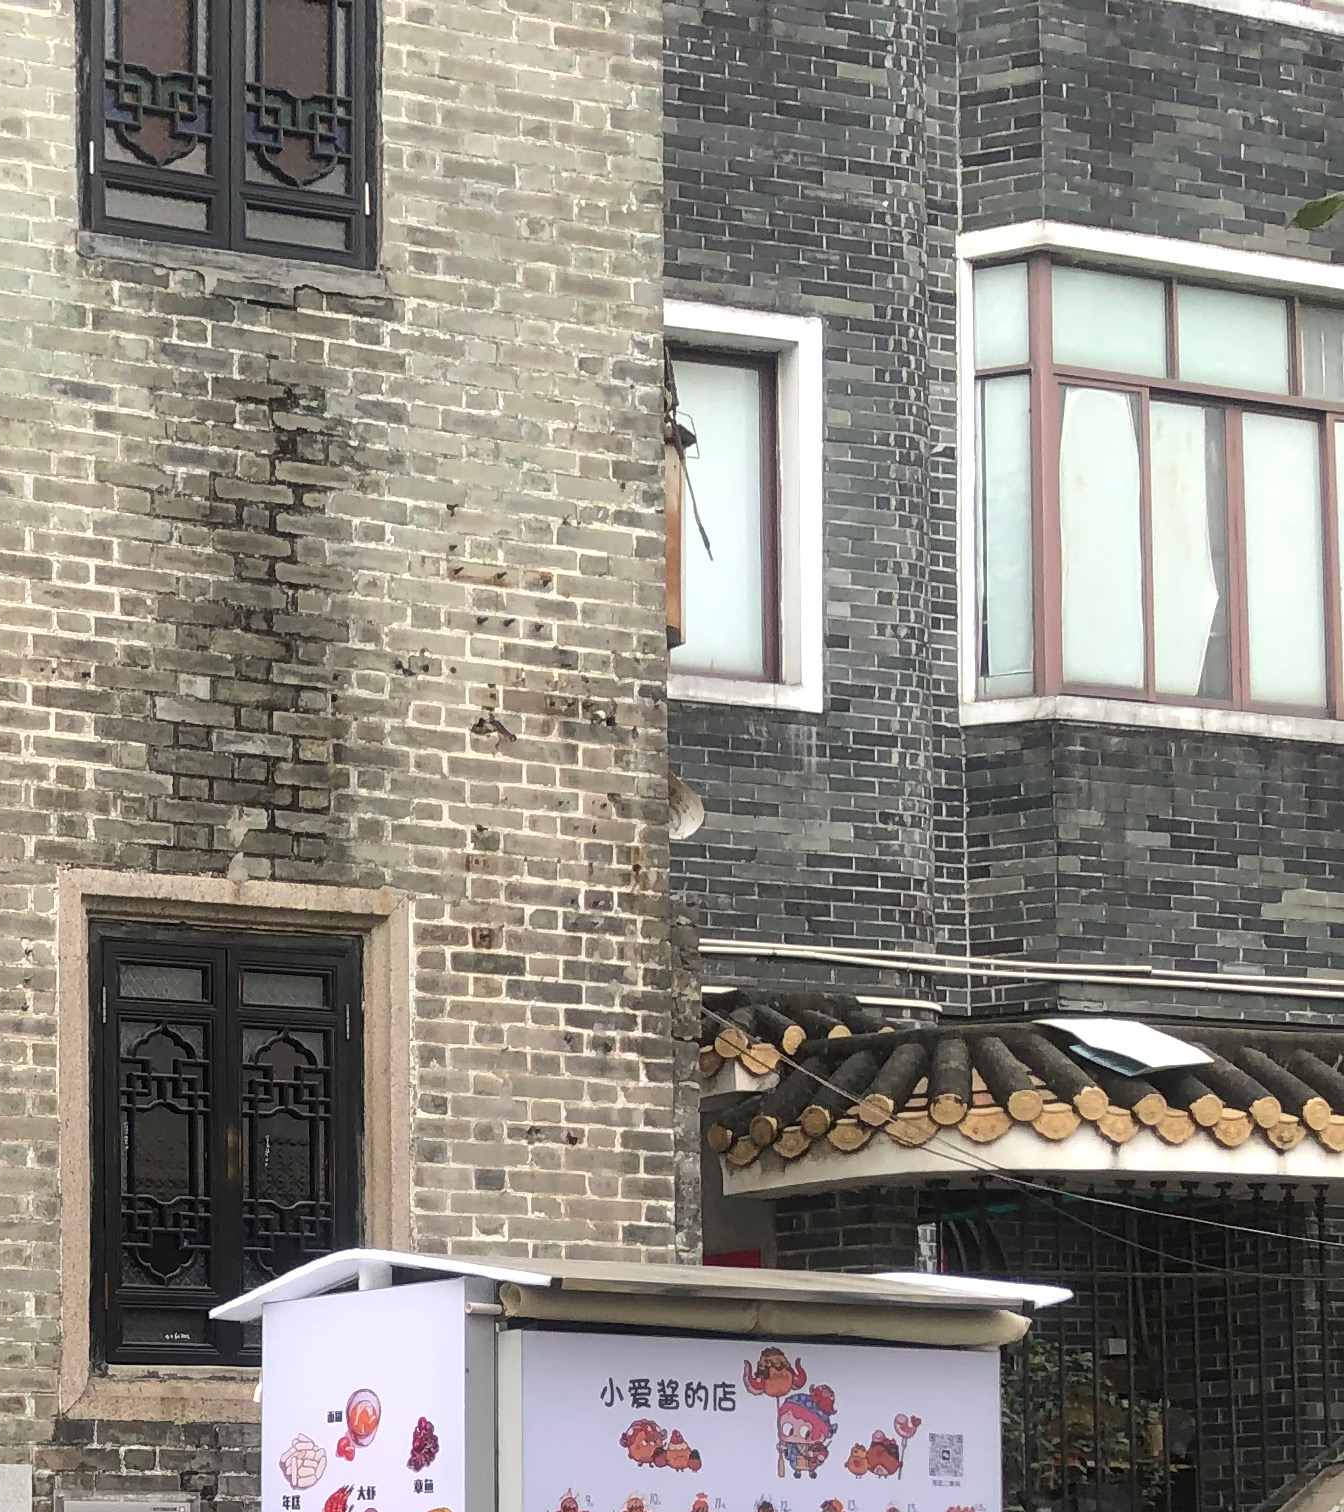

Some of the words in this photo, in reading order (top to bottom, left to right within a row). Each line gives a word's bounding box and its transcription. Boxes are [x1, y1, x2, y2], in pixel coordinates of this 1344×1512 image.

[599, 1377, 737, 1412] 小爱酱的店
[357, 1486, 376, 1501] 大虾
[413, 1479, 434, 1494] 章鱼
[282, 1495, 301, 1511] 年糕
